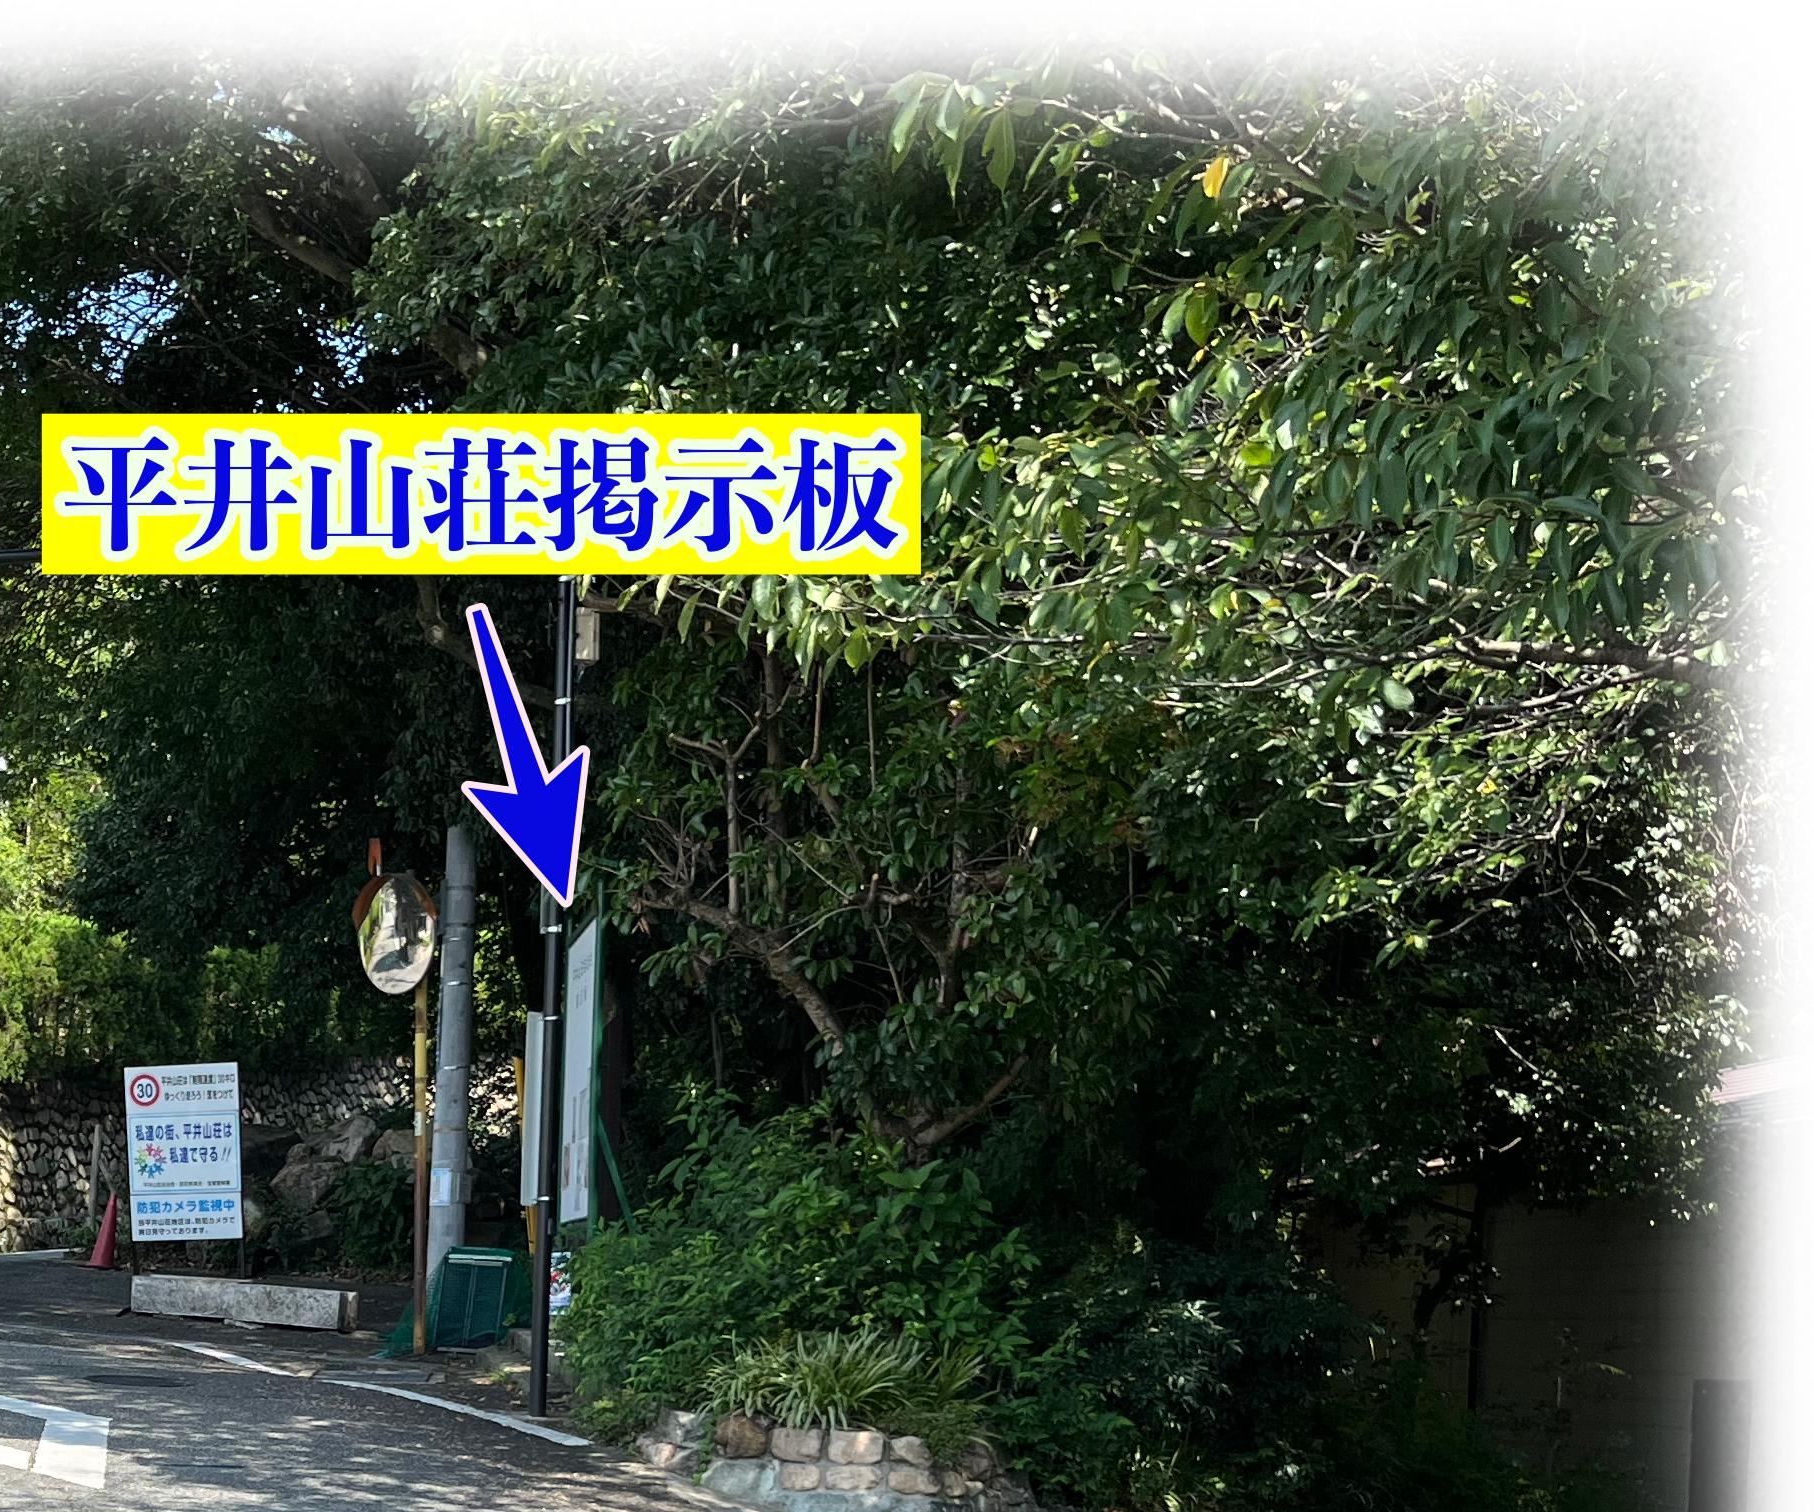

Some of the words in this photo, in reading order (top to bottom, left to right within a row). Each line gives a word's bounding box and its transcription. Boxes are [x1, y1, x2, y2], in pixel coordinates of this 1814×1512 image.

[136, 1083, 153, 1099] 30
[137, 1199, 235, 1214] 防犯カメラ監視中
